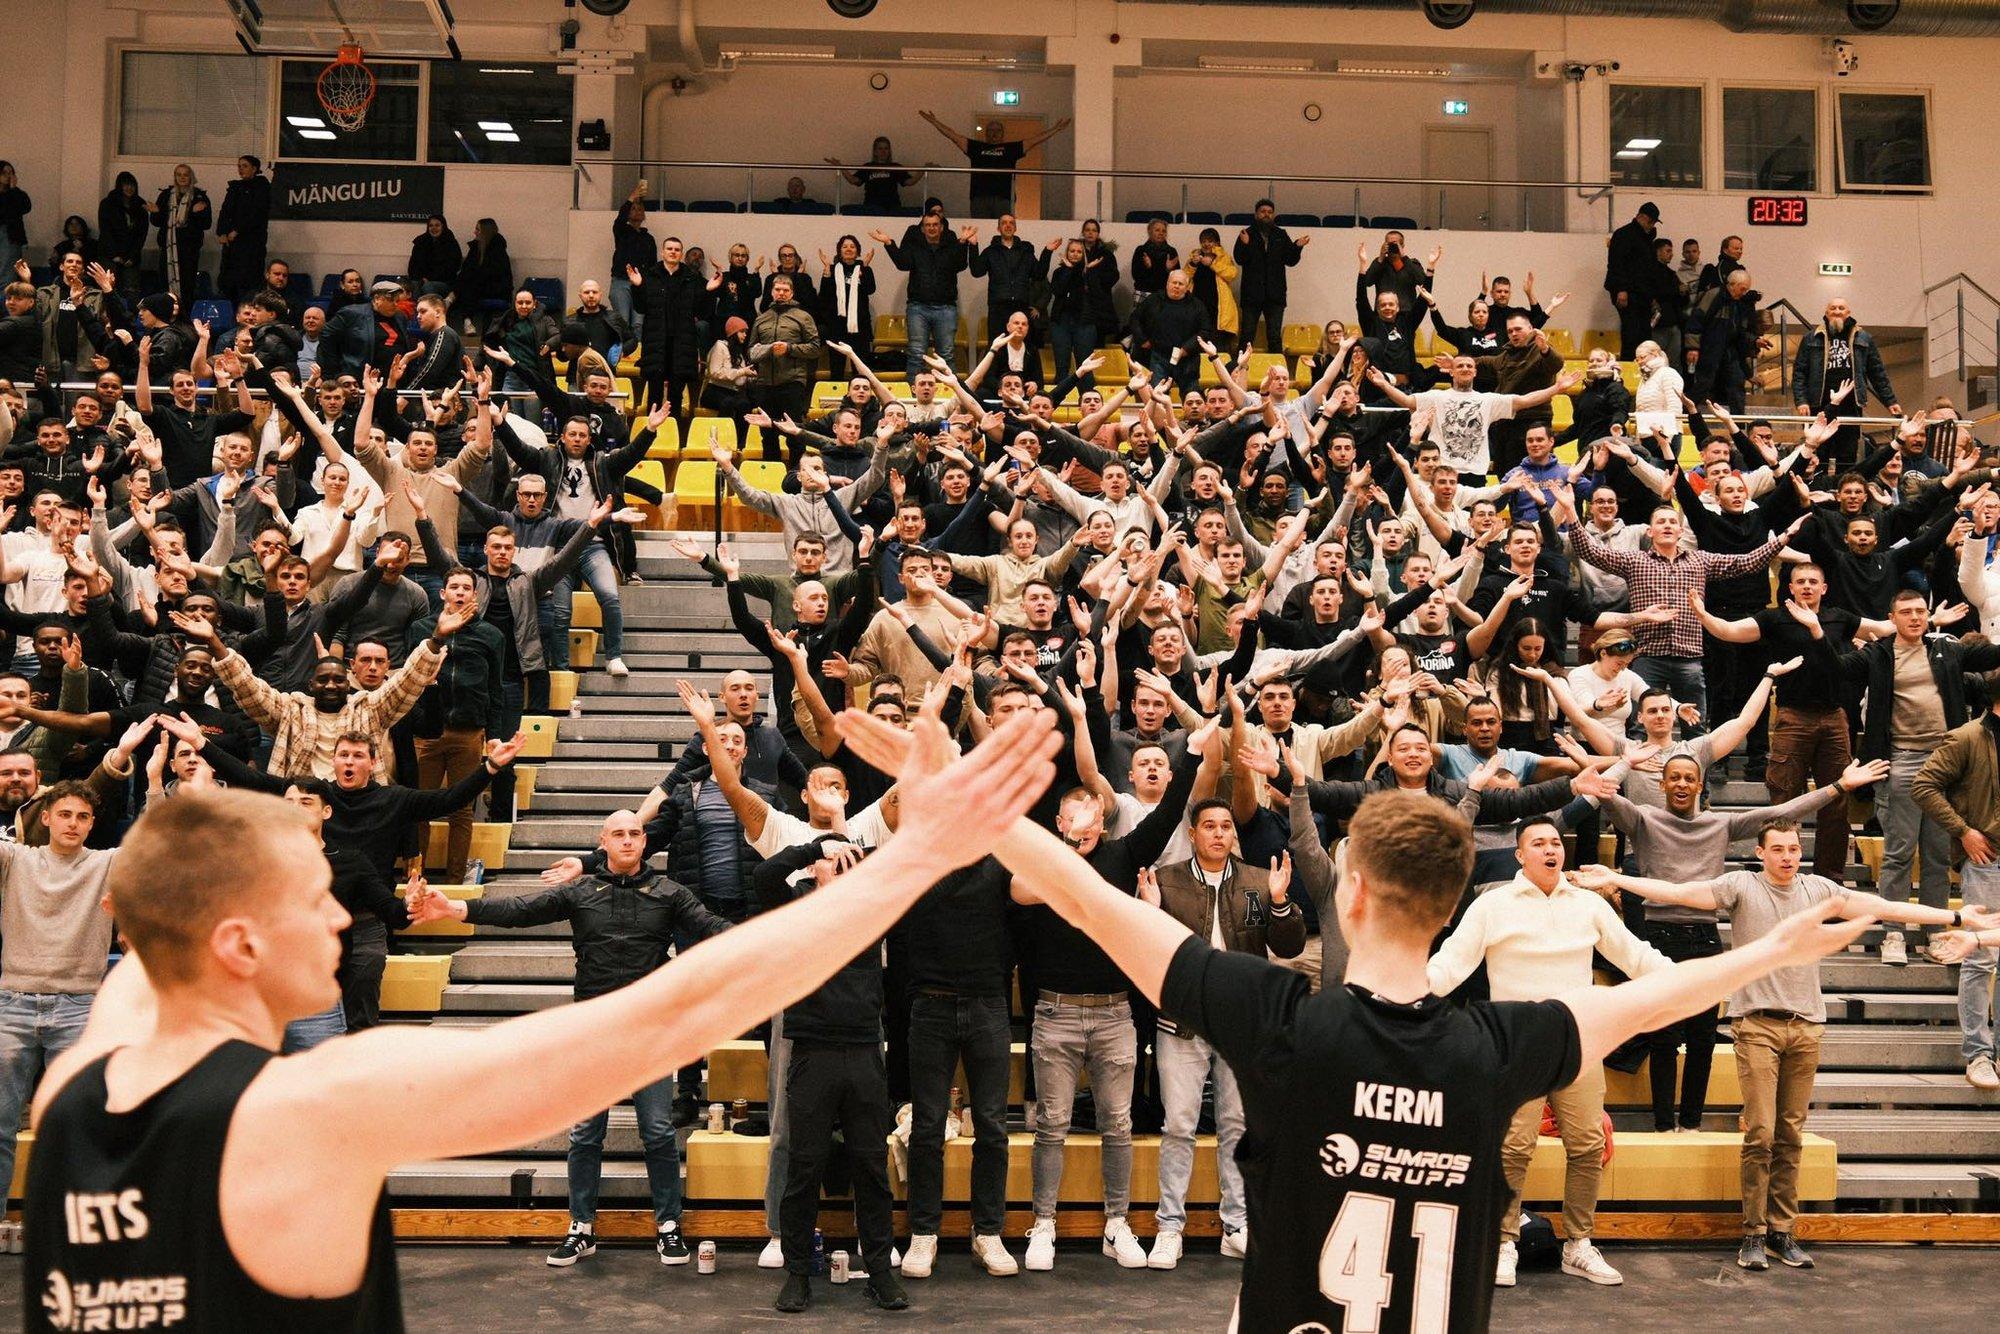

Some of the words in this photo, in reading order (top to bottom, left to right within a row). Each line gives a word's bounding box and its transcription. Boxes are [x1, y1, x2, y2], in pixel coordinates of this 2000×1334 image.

[288, 182, 366, 206] MÄNGU
[371, 179, 402, 199] ILU
[1753, 199, 1804, 222] 20:32
[1244, 890, 1267, 927] A
[1353, 1081, 1444, 1127] KERM
[1359, 1161, 1466, 1188] GRUPP
[1364, 1143, 1472, 1173] SUMROS
[64, 1188, 149, 1244] IETS
[1318, 1190, 1460, 1334] 41
